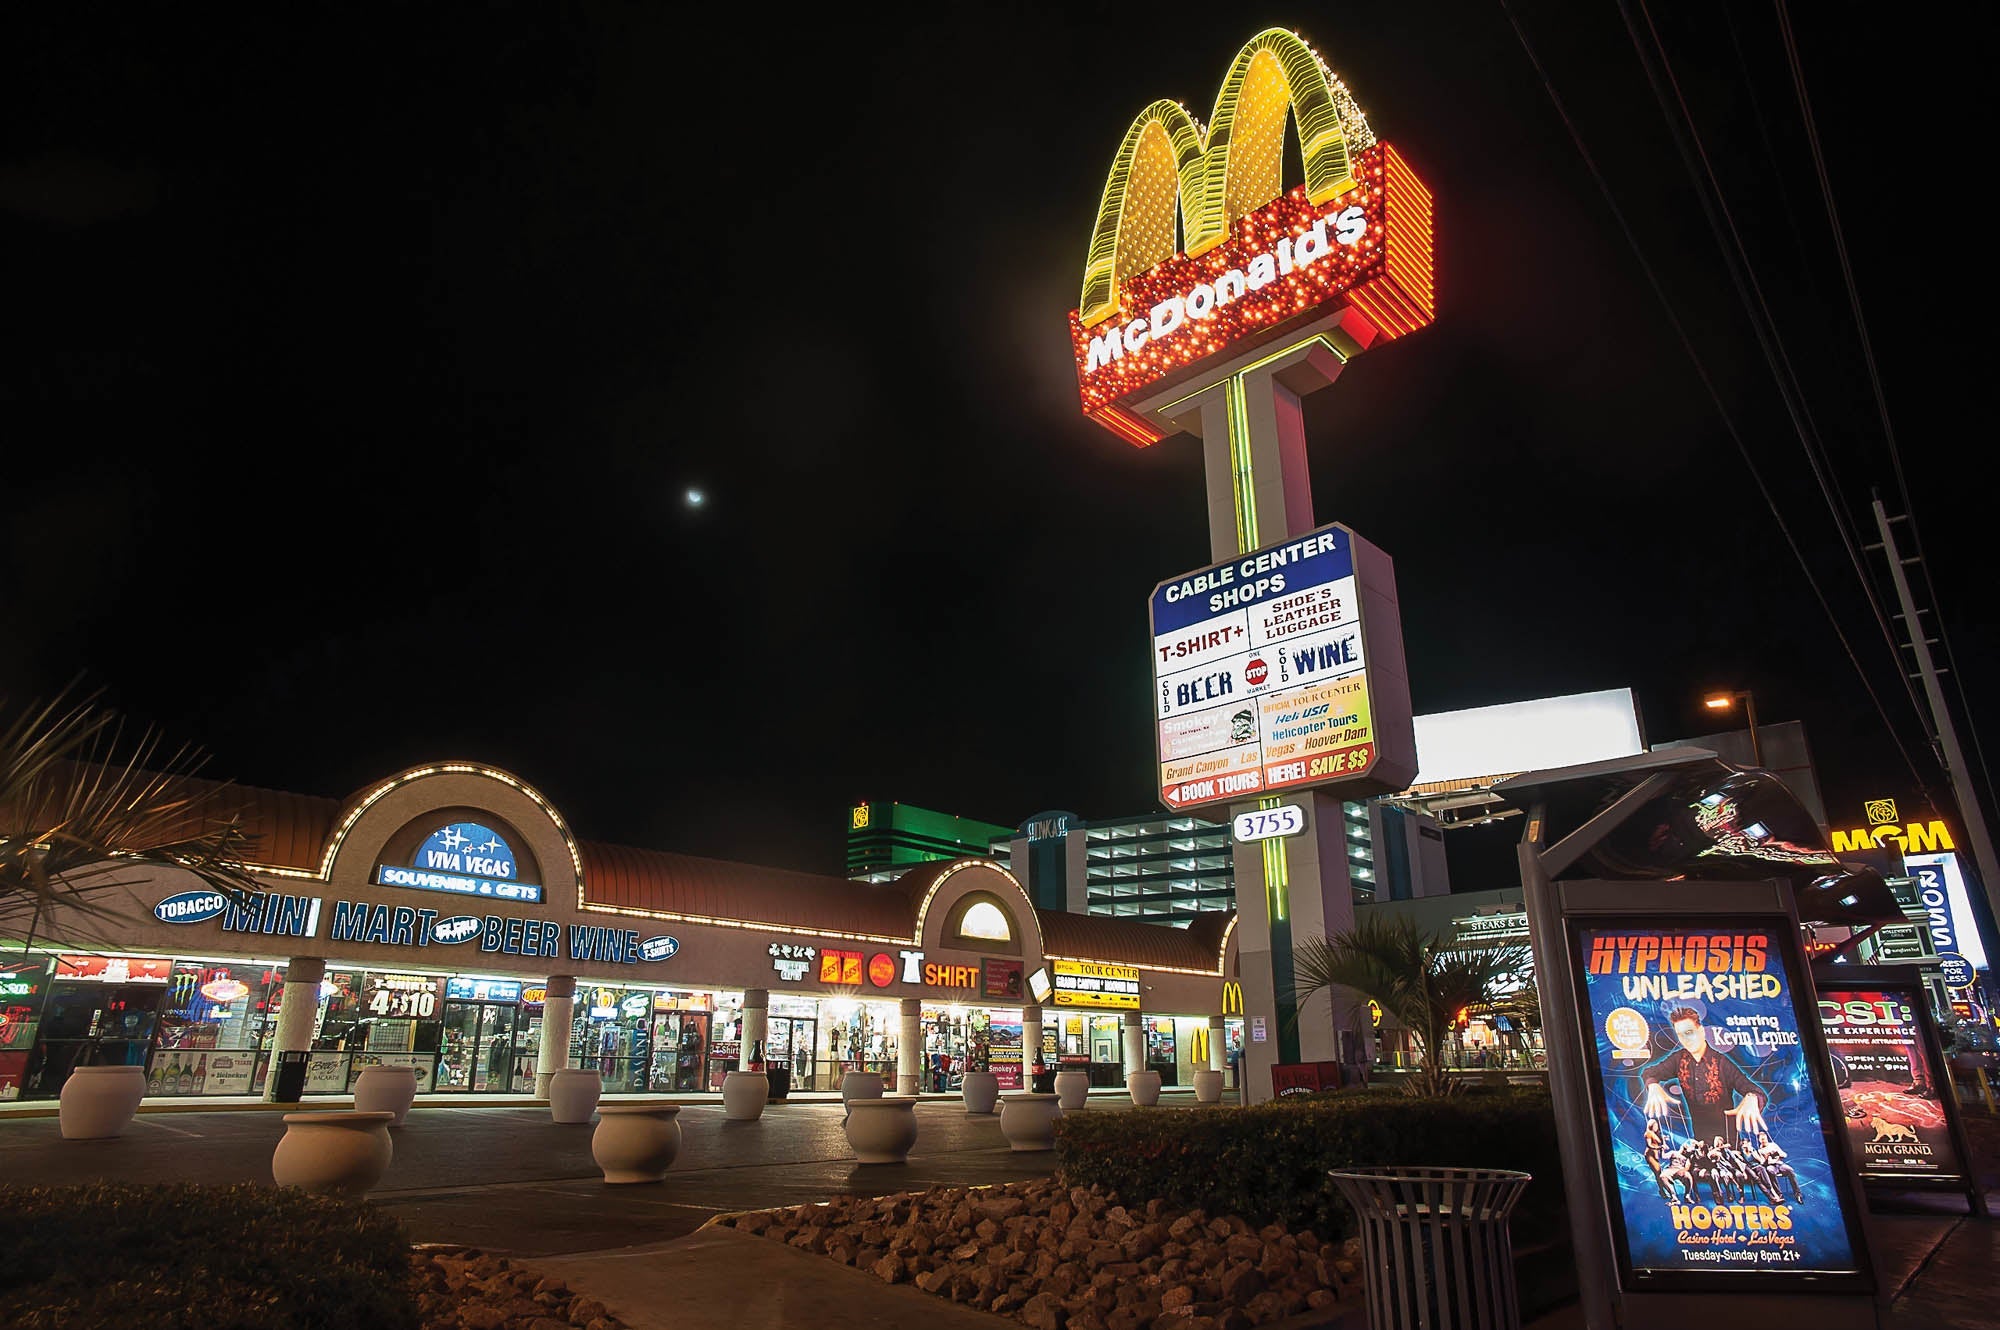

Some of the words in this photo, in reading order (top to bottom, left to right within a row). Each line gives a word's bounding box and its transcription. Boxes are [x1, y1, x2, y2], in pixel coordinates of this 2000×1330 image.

[1086, 206, 1367, 373] McDonald's
[1166, 566, 1234, 602] CABLE
[1240, 533, 1336, 577] CENTER
[1210, 574, 1286, 612] SHOPS
[1272, 588, 1331, 612] SHOE'S
[1264, 598, 1341, 628] LEATHER
[1266, 611, 1341, 639] LUGGAGE
[1160, 625, 1244, 662] T-SHIRT+
[1293, 634, 1357, 675] WINE
[1246, 666, 1267, 679] STOP
[1278, 648, 1289, 682] COLD
[1162, 681, 1170, 713] COLD
[1177, 671, 1233, 706] BEER
[1247, 684, 1271, 695] MARKET
[1293, 693, 1318, 707] TOUR
[1320, 682, 1361, 699] CENTER
[1272, 720, 1326, 741] Helicopter
[1327, 713, 1358, 729] Tours
[1166, 763, 1194, 780] Grand
[1196, 757, 1229, 773] Canyon
[1240, 751, 1258, 764] Las
[1265, 743, 1296, 758] Vegas
[1305, 732, 1343, 750] Hoover
[1344, 727, 1368, 742] Dam
[1182, 780, 1215, 801] BOOK
[1217, 771, 1259, 794] TOURS
[1267, 761, 1306, 785] HERE!
[1309, 753, 1346, 777] SAVE
[1347, 748, 1369, 771] $$
[1244, 811, 1295, 837] 3755
[1831, 820, 1955, 856] MGM
[427, 850, 460, 871] VIVA
[466, 855, 510, 877] VEGAS
[479, 882, 492, 894] &
[495, 883, 537, 900] GIFTS
[158, 895, 223, 918] TOBACCO
[223, 889, 322, 937] MINI
[332, 900, 438, 946] MART
[1919, 870, 1952, 946] ROSS
[1471, 920, 1506, 931] STEAKS
[1508, 918, 1515, 927] &
[481, 914, 561, 957] BEER
[569, 924, 640, 964] WINE
[1589, 935, 1768, 975] HYPNOSIS
[925, 963, 979, 988] SHIRT
[1080, 964, 1103, 976] TOUR
[1105, 967, 1138, 978] CENTER
[373, 979, 437, 992] T-SHIRTS
[524, 989, 547, 1003] OPE
[1622, 973, 1781, 1003] UNLEASHED
[369, 990, 389, 1015] 4
[1817, 1001, 1912, 1025] CSI:
[1726, 1015, 1779, 1027] starring
[1844, 1027, 1916, 1035] EXPERIENCE
[1712, 1027, 1751, 1046] Kevin
[1753, 1028, 1799, 1051] Lepine
[216, 1071, 248, 1079] Heineken
[988, 1065, 1017, 1073] Smokey's
[1865, 1144, 1892, 1154] MGM
[1671, 1205, 1793, 1230] HOOTERS
[1677, 1230, 1709, 1244] Casino
[1711, 1229, 1737, 1245] Hotel
[1747, 1231, 1768, 1246] Las
[1767, 1231, 1795, 1249] Vegas
[1682, 1249, 1758, 1263] Tuesday-Sunday
[1760, 1250, 1780, 1262] 8pm
[1782, 1250, 1801, 1261] 21+
